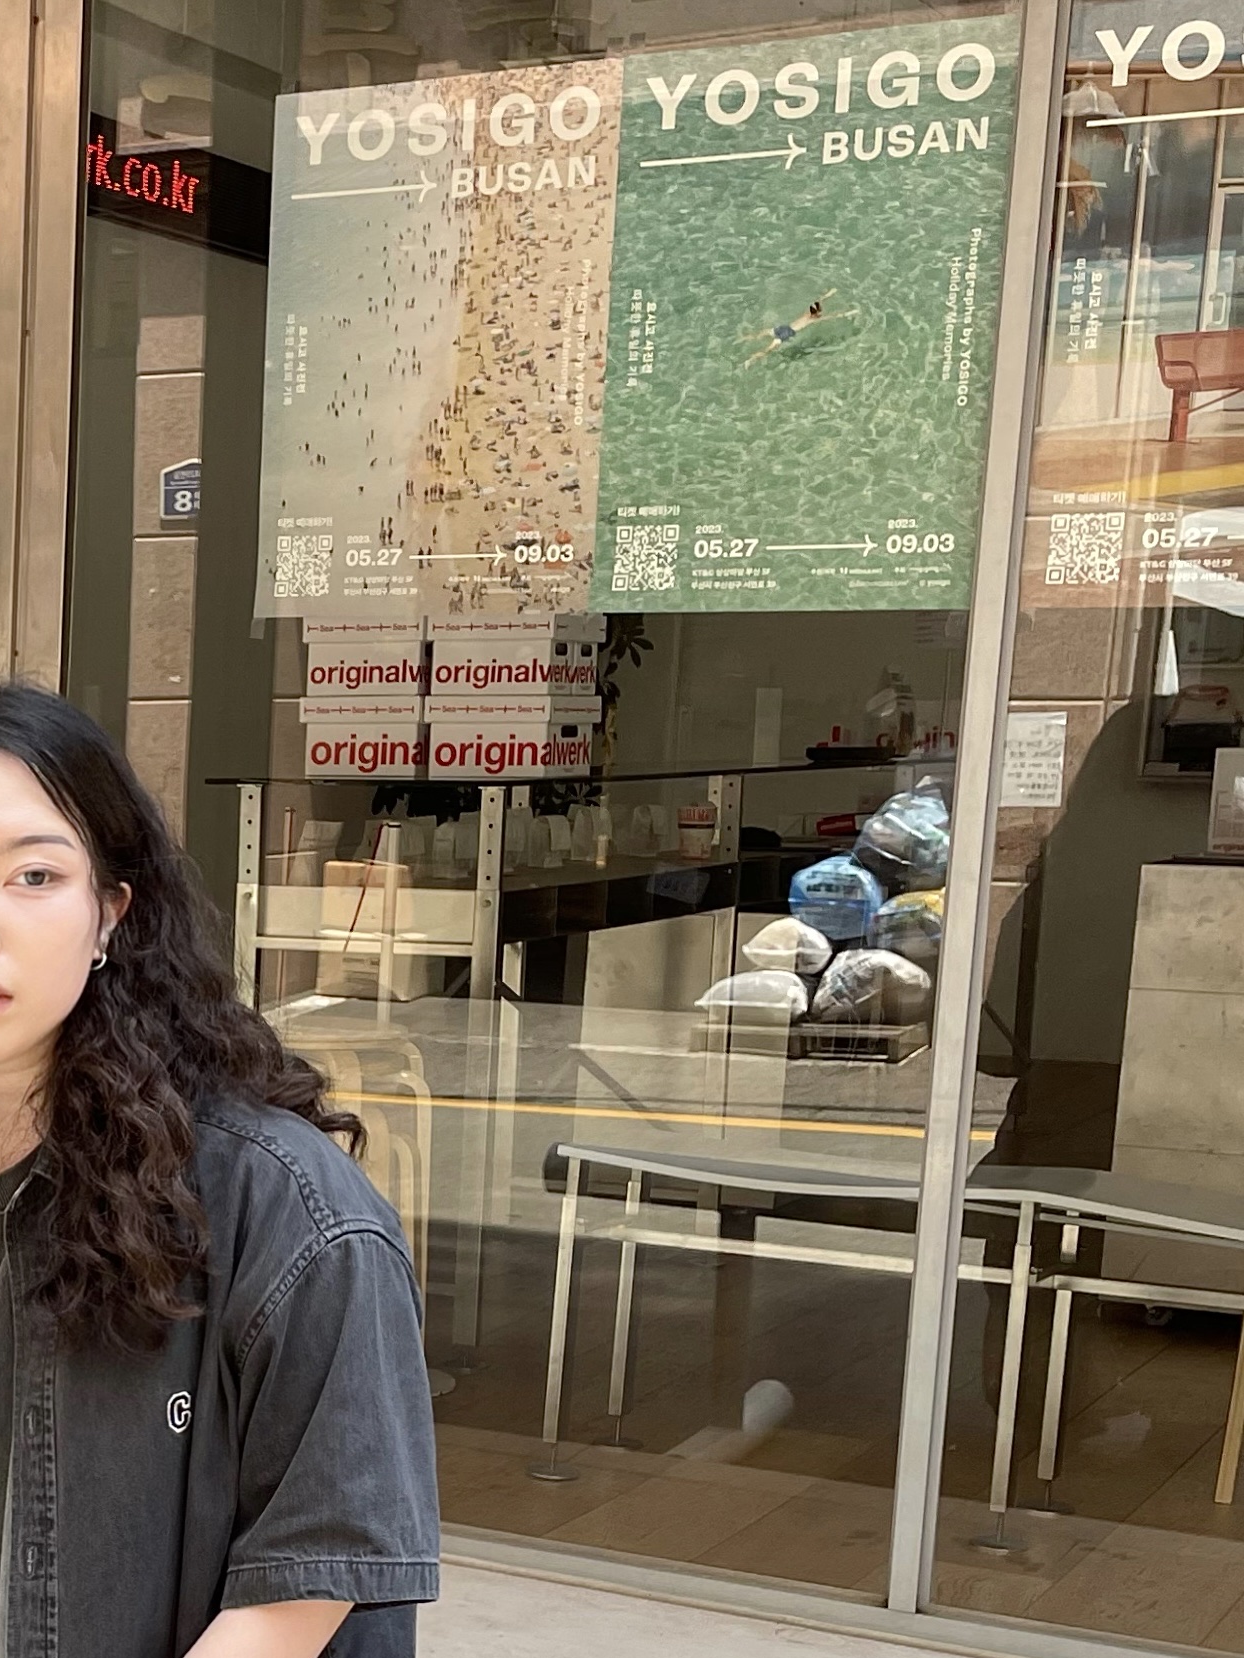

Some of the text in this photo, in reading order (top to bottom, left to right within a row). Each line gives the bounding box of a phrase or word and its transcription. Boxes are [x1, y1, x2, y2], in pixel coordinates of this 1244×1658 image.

[1095, 19, 1244, 87] YO
[646, 42, 996, 130] YOSIGO
[296, 85, 601, 166] YOSIGO
[821, 116, 990, 165] BUSAN
[450, 155, 596, 199] BUSAN
[1088, 271, 1102, 308] 요시고
[645, 301, 657, 336] 요시고
[942, 256, 962, 381] Holiday Memories
[956, 227, 982, 407] Photographs by YOSIGO
[297, 325, 308, 358] 요시고
[573, 258, 592, 426] Photographs by YOSIGO
[695, 524, 724, 534] 2023.
[886, 533, 955, 554] 09.03
[887, 518, 918, 529] 2023.
[1141, 526, 1219, 549] 05.27
[345, 548, 403, 567] 05.27
[514, 543, 574, 563] 09.03
[693, 538, 759, 559] 05.27
[434, 732, 591, 775] originalwerk
[166, 1390, 192, 1434] C
